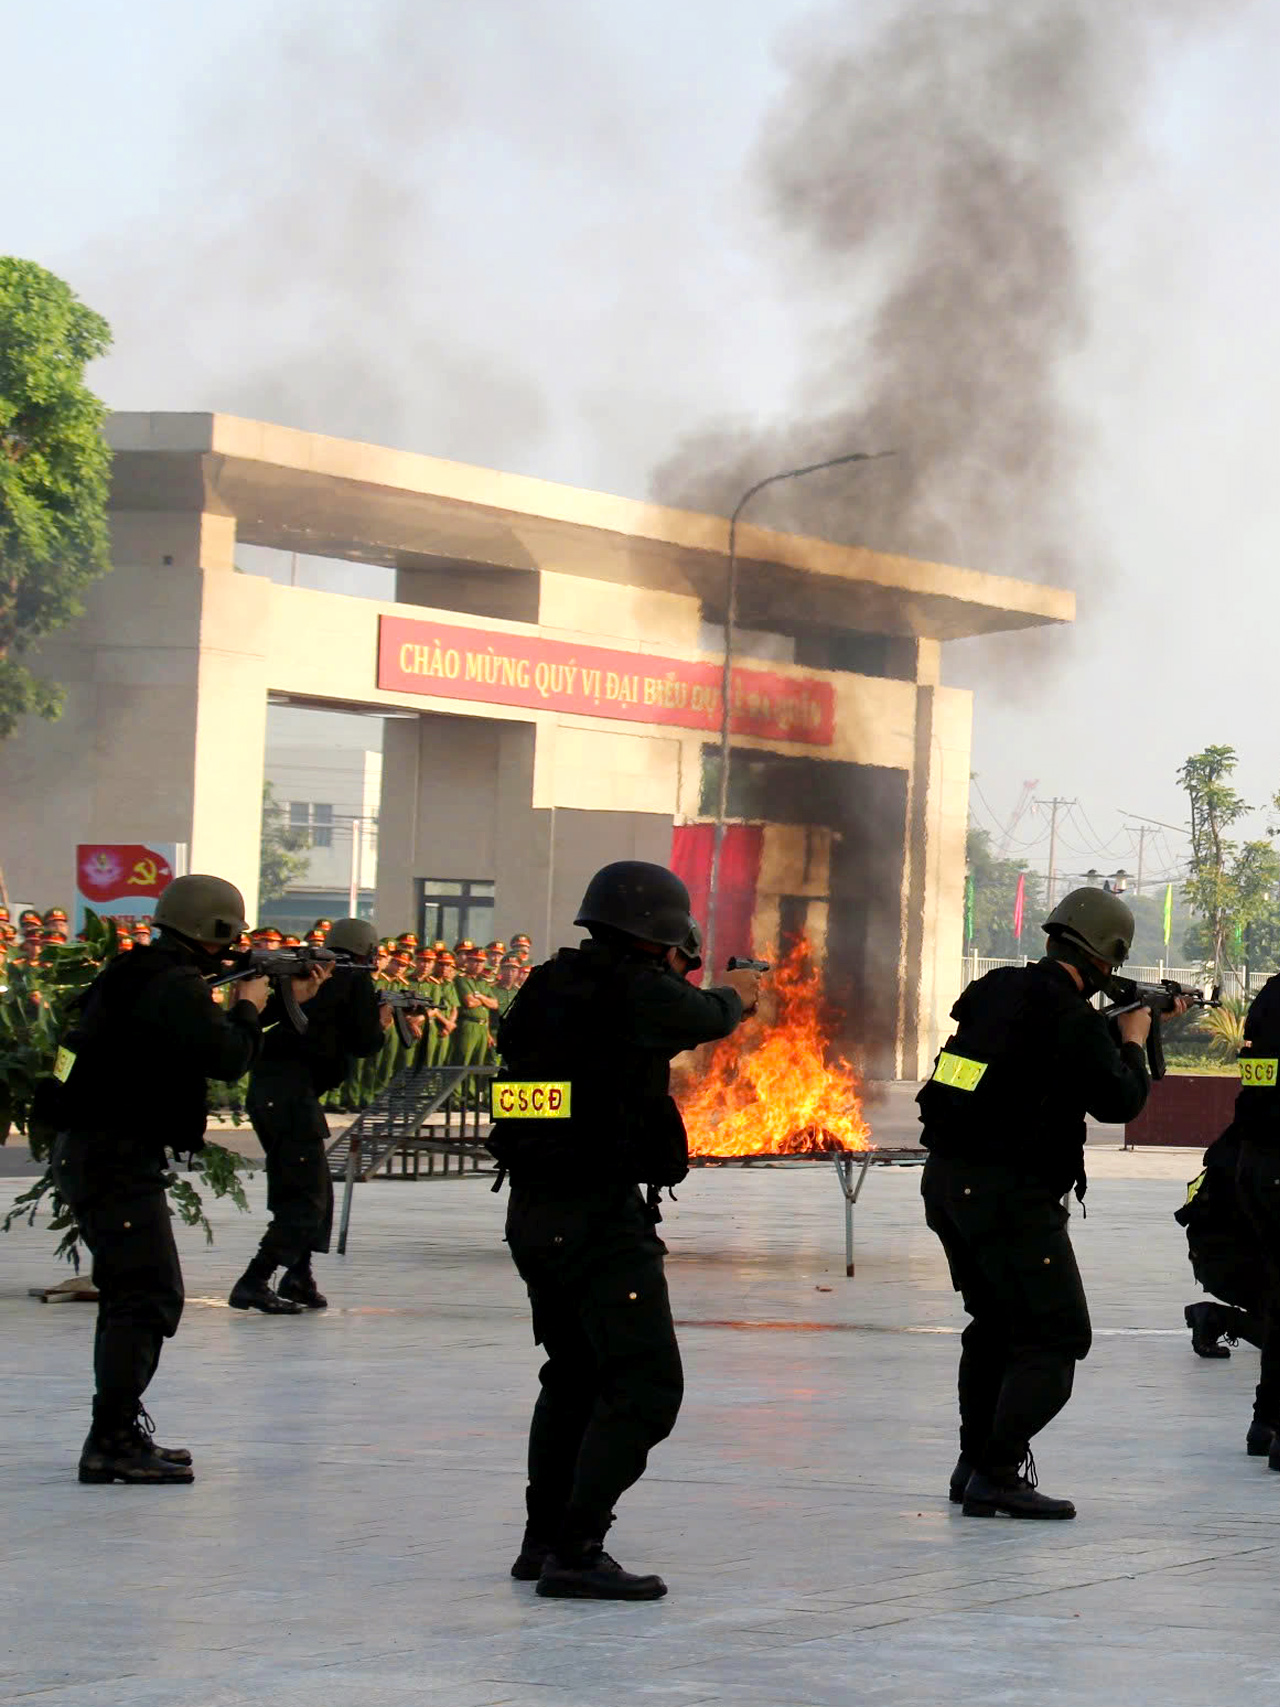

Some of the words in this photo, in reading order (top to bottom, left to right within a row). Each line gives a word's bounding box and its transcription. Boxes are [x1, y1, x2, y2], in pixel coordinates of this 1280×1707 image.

[399, 638, 461, 680] CHÀO
[464, 646, 531, 689] MỪNG
[535, 657, 578, 698] QUÝ
[581, 668, 602, 706] VỊ
[605, 672, 639, 710] ĐẠI
[500, 1087, 562, 1112] CSCĐ
